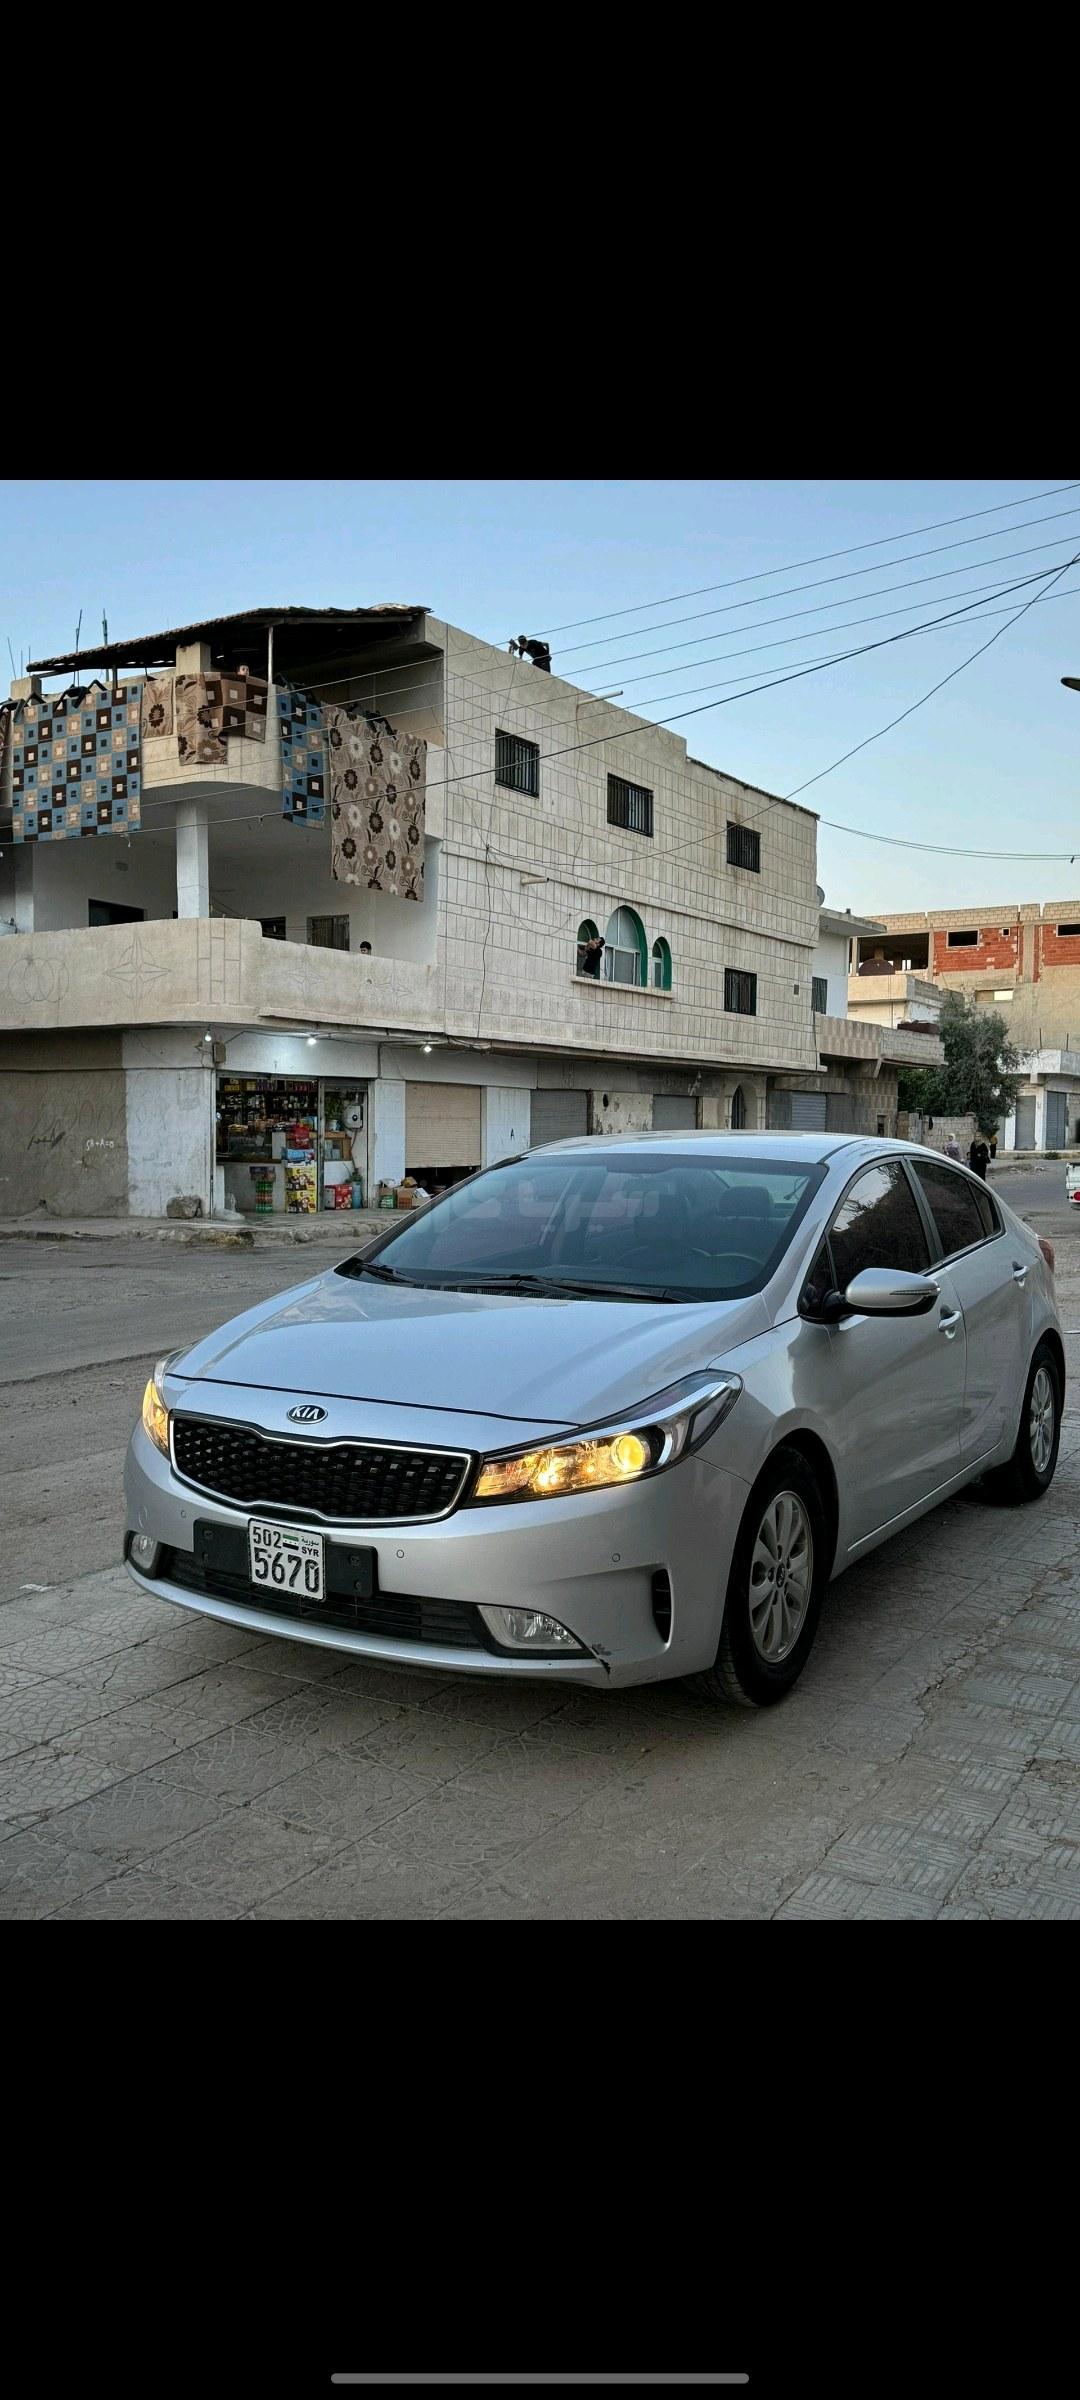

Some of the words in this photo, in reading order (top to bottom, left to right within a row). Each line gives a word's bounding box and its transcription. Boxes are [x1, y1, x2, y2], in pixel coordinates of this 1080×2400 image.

[291, 1406, 320, 1420] KIA
[252, 1527, 282, 1549] 502
[301, 1546, 320, 1558] SYR
[254, 1547, 320, 1594] 5670
